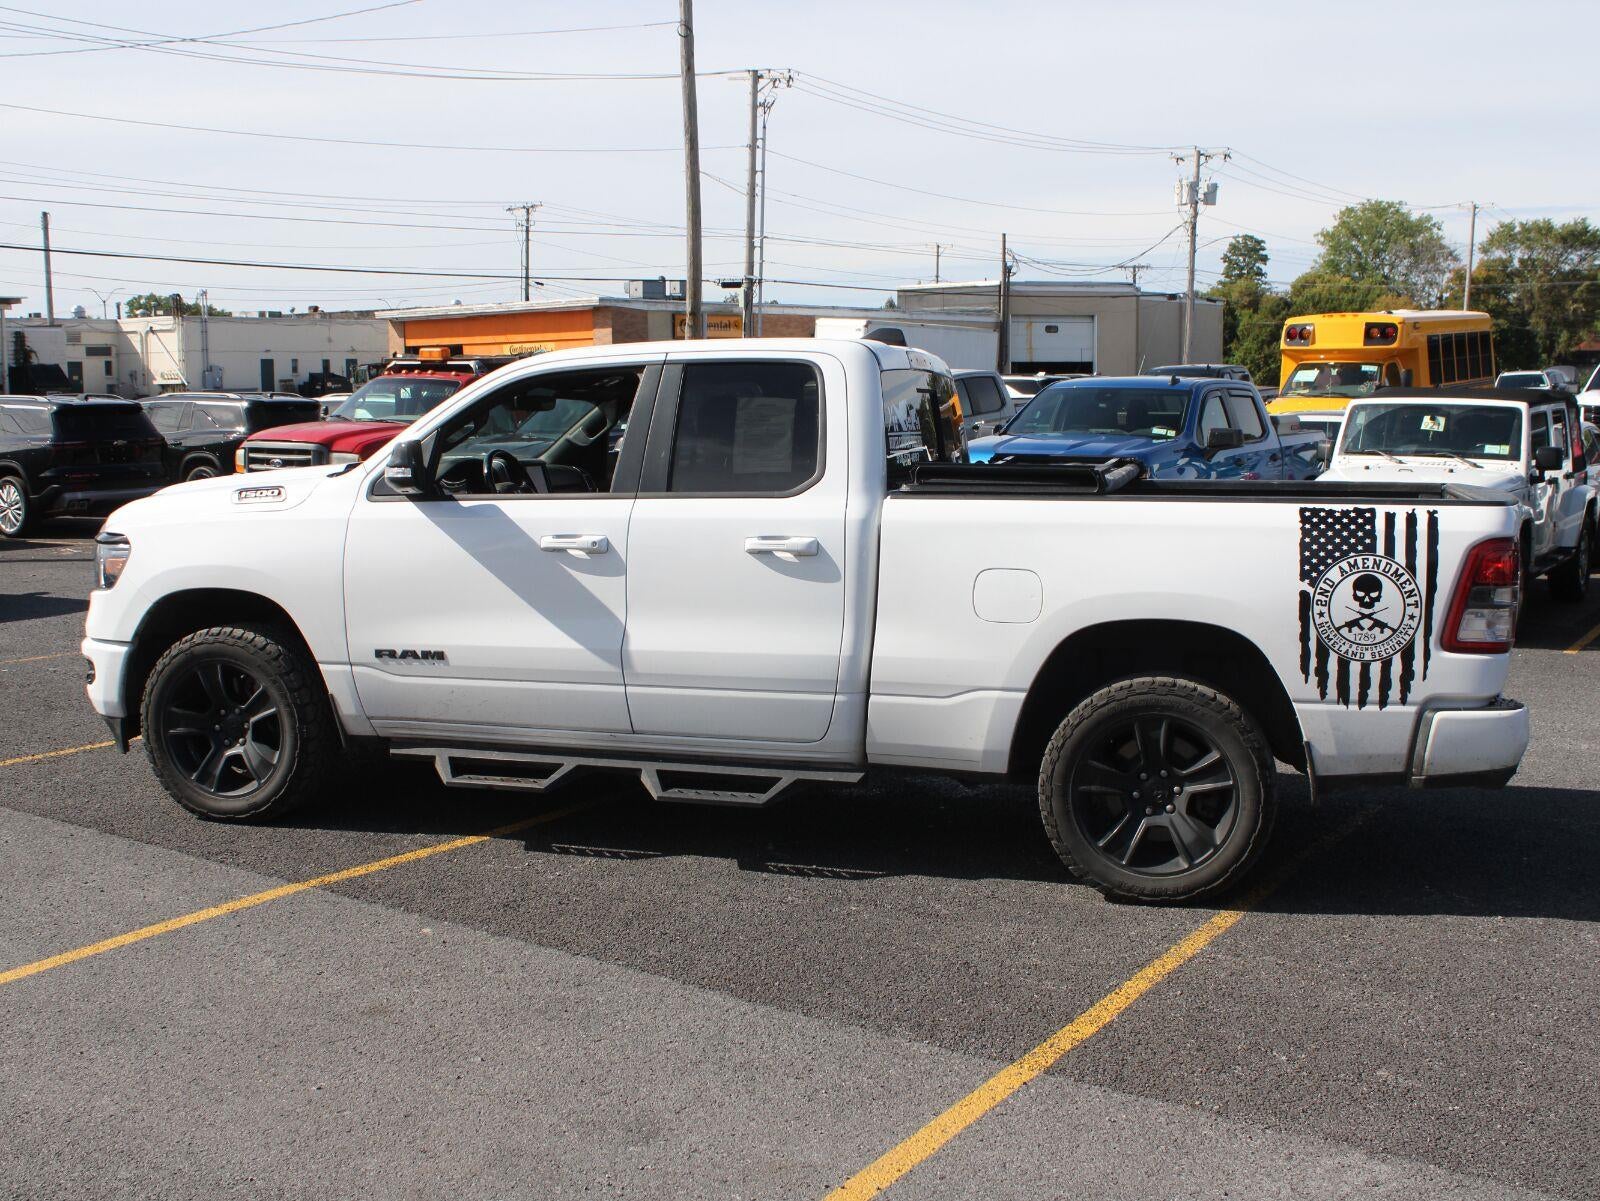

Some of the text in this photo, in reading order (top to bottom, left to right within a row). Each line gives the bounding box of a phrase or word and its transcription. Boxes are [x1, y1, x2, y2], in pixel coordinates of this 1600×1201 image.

[240, 489, 281, 498] 1500
[1315, 557, 1419, 609] 2ND AMENDMENT
[1317, 622, 1414, 659] HOMELAND SECURITY
[1324, 621, 1409, 652] AMERICA'S CONSTITUTIONAL
[1353, 633, 1377, 643] 1789
[374, 649, 446, 661] RAM
